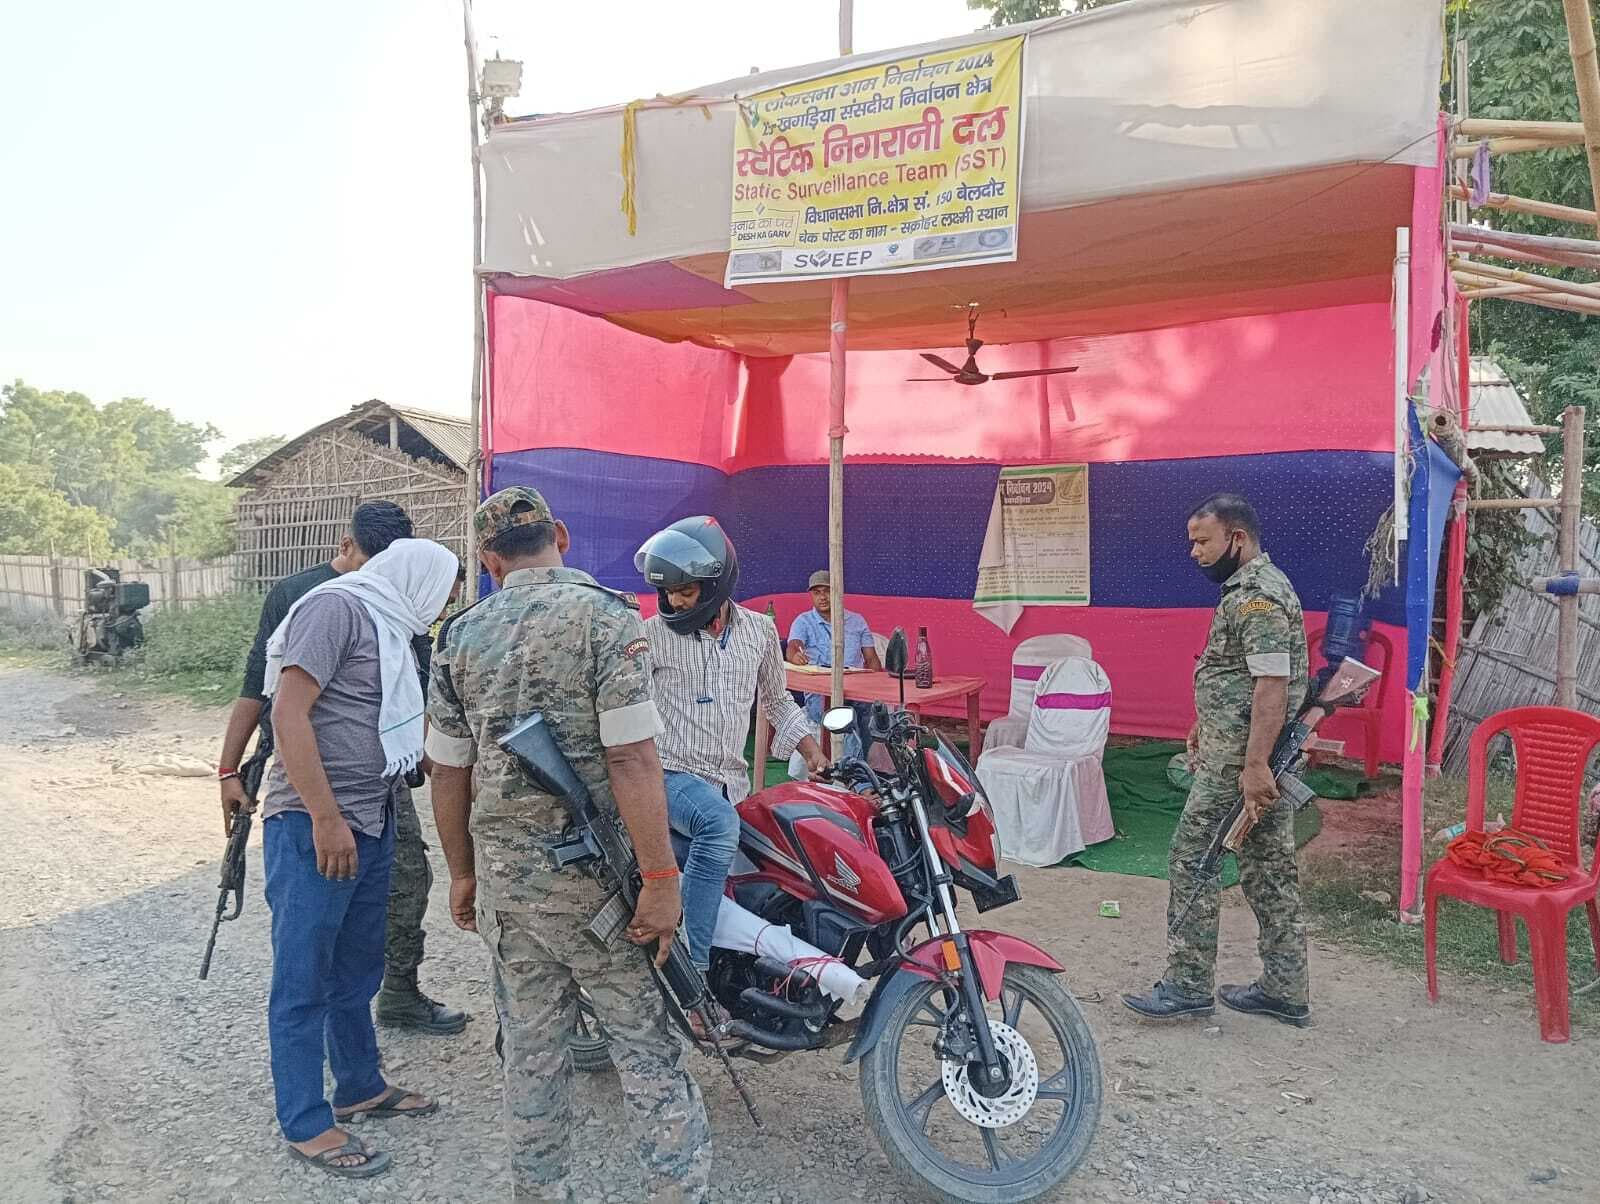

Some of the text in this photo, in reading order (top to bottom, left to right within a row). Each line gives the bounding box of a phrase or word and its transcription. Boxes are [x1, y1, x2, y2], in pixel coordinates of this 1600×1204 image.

[765, 52, 994, 112] लोकसभा आम निर्वाचन 2024
[840, 93, 895, 120] संसदीय
[900, 81, 960, 108] निर्वाचन
[966, 74, 992, 96] क्षेत्र
[822, 106, 944, 168] निगरानी
[952, 106, 1009, 145] दल
[735, 146, 1007, 201] Static Surveillance Team (SST)
[799, 230, 819, 243] चेक
[823, 228, 846, 243] पोस्ट
[849, 227, 863, 240] का
[865, 224, 887, 238] नाम
[977, 205, 1009, 221] स्थान
[805, 205, 864, 224] विधानसभा
[936, 190, 953, 206] 150
[768, 230, 791, 238] GARV
[793, 250, 873, 268] SWEEP
[1032, 481, 1052, 494] 2024
